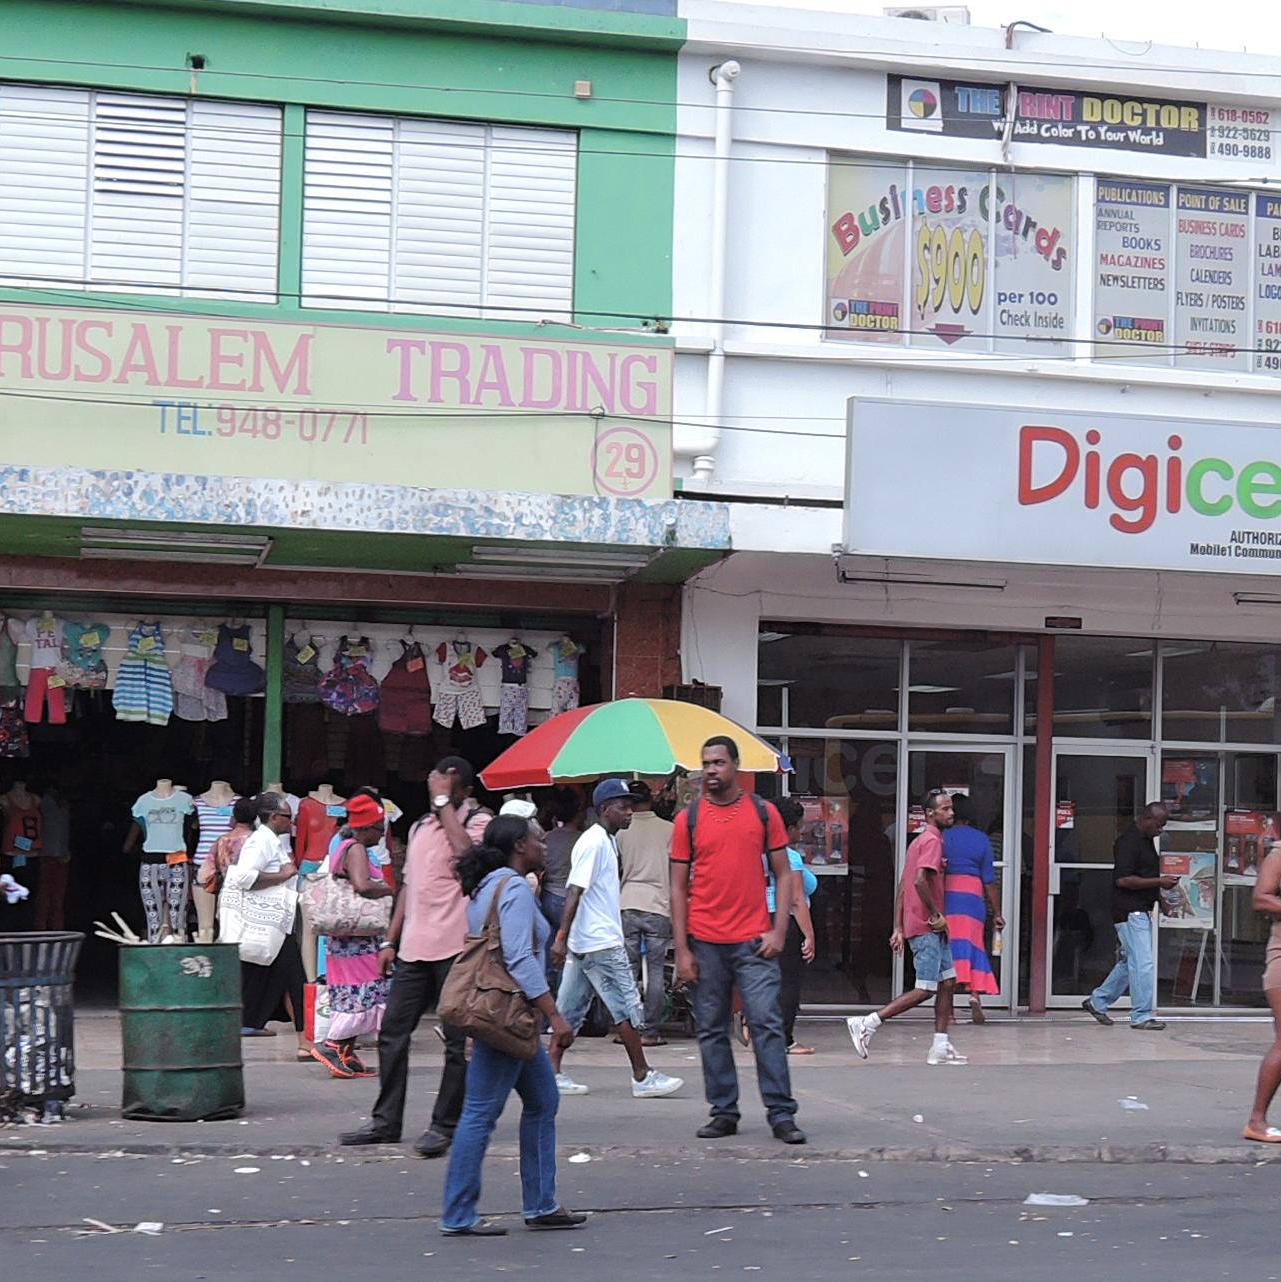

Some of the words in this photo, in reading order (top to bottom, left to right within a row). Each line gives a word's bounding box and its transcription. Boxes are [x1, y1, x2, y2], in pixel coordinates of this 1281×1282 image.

[955, 86, 1000, 115] THE
[1004, 90, 1075, 121] RINT
[1082, 97, 1199, 132] DOCTOR
[1218, 108, 1270, 125] 618-0562
[1014, 119, 1038, 135] Add
[1040, 122, 1075, 139] Color
[1076, 125, 1097, 141] To
[1098, 126, 1126, 143] Your
[1127, 129, 1164, 146] World
[1217, 142, 1271, 160] 490-9888
[1098, 187, 1165, 206] PUBLICATIONS
[1179, 193, 1206, 209] POINT
[1209, 196, 1221, 210] OF
[1223, 197, 1247, 212] SALE
[1098, 207, 1135, 220] ANNUAL
[832, 184, 968, 257] Business
[979, 184, 1068, 271] Cards
[1098, 220, 1140, 234] REPORTS
[1179, 219, 1217, 236] BUSINESS
[1219, 222, 1246, 238] CARDS
[1122, 236, 1162, 252] BOOKS
[1190, 244, 1233, 262] BROCHURES
[916, 215, 985, 321] $900
[1100, 253, 1166, 270] MAGAZINES
[1100, 273, 1166, 291] NEWSLETTERS
[1190, 268, 1232, 286] CALENDERS
[997, 291, 1024, 306] per
[1029, 291, 1058, 306] 100
[1177, 291, 1204, 308] FLYERS
[1212, 294, 1246, 312] POSTERS
[850, 313, 898, 330] DOCTOR
[999, 308, 1031, 328] Check
[1034, 311, 1064, 329] Inside
[1191, 316, 1236, 334] INVITATIONS
[1114, 327, 1164, 342] DOCTOR
[386, 337, 658, 416] TRADING
[217, 403, 368, 445] 948-0771
[604, 441, 647, 479] 29
[1190, 543, 1232, 557] Mobile1
[36, 639, 57, 648] TAL
